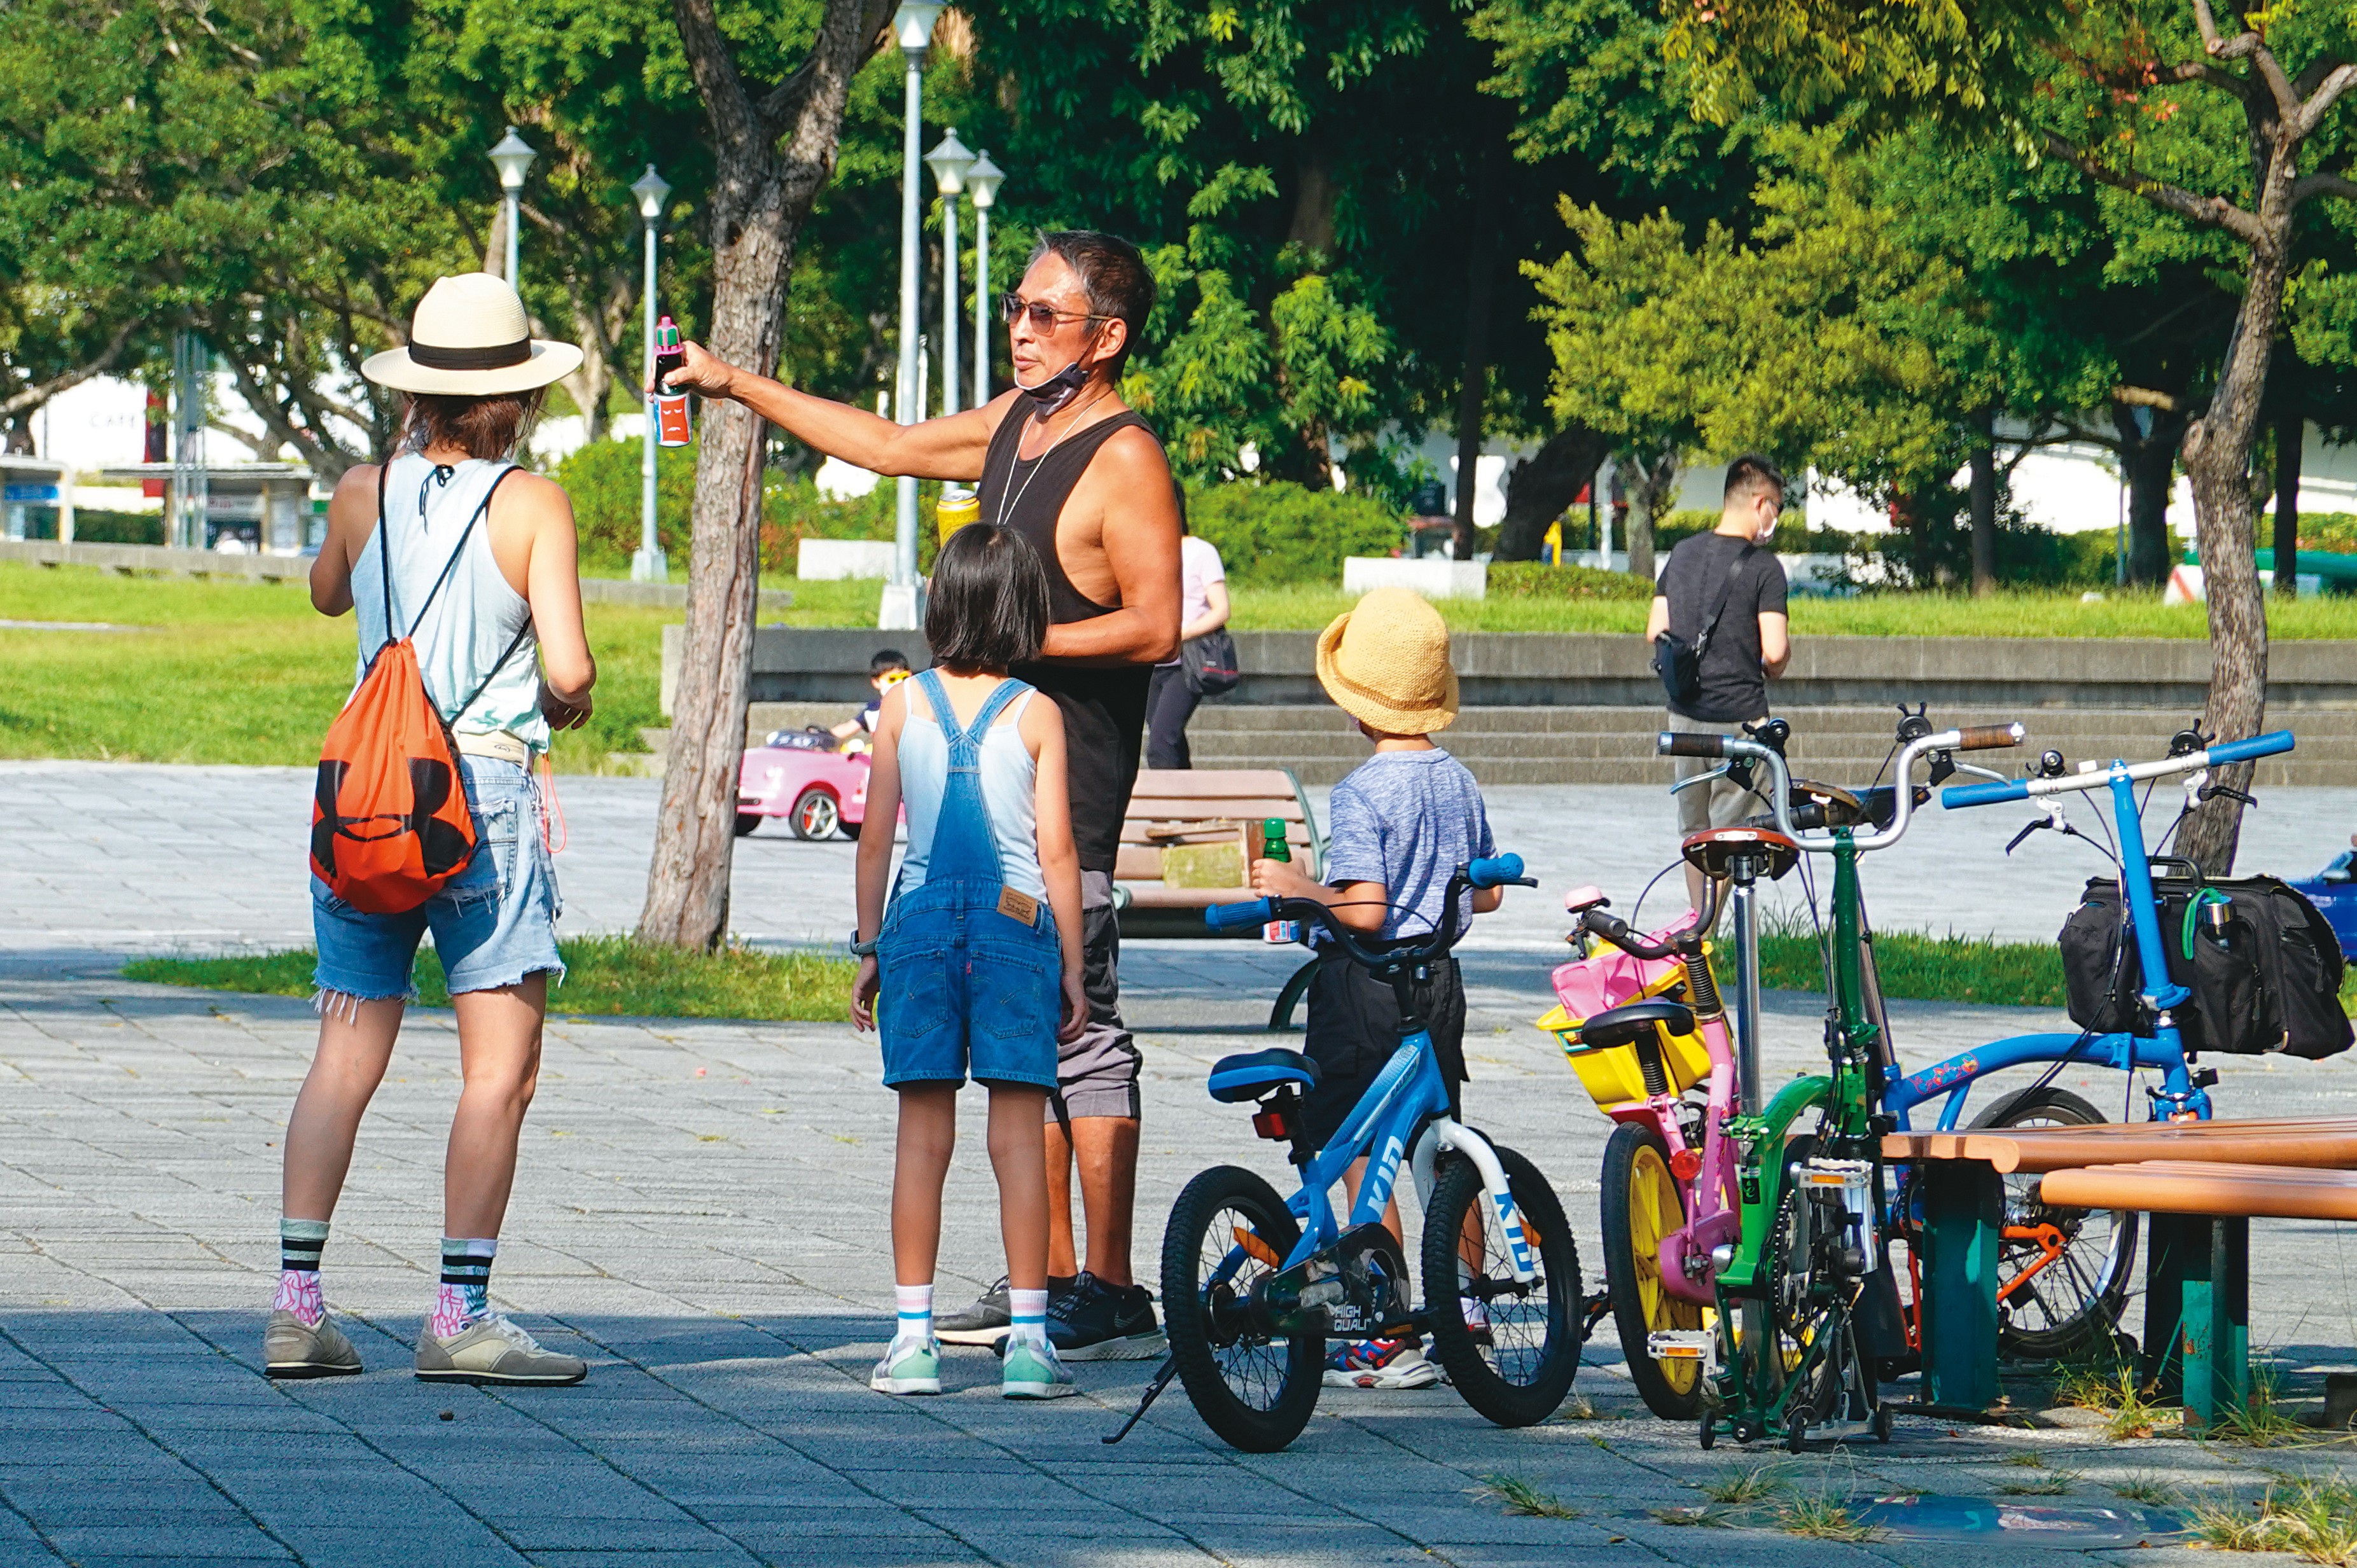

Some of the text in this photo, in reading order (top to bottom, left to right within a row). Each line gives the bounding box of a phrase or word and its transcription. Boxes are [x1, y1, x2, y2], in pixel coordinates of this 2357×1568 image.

[1367, 1135, 1403, 1218] KID
[1494, 1191, 1534, 1272] KID
[1335, 1305, 1361, 1318] HIGH
